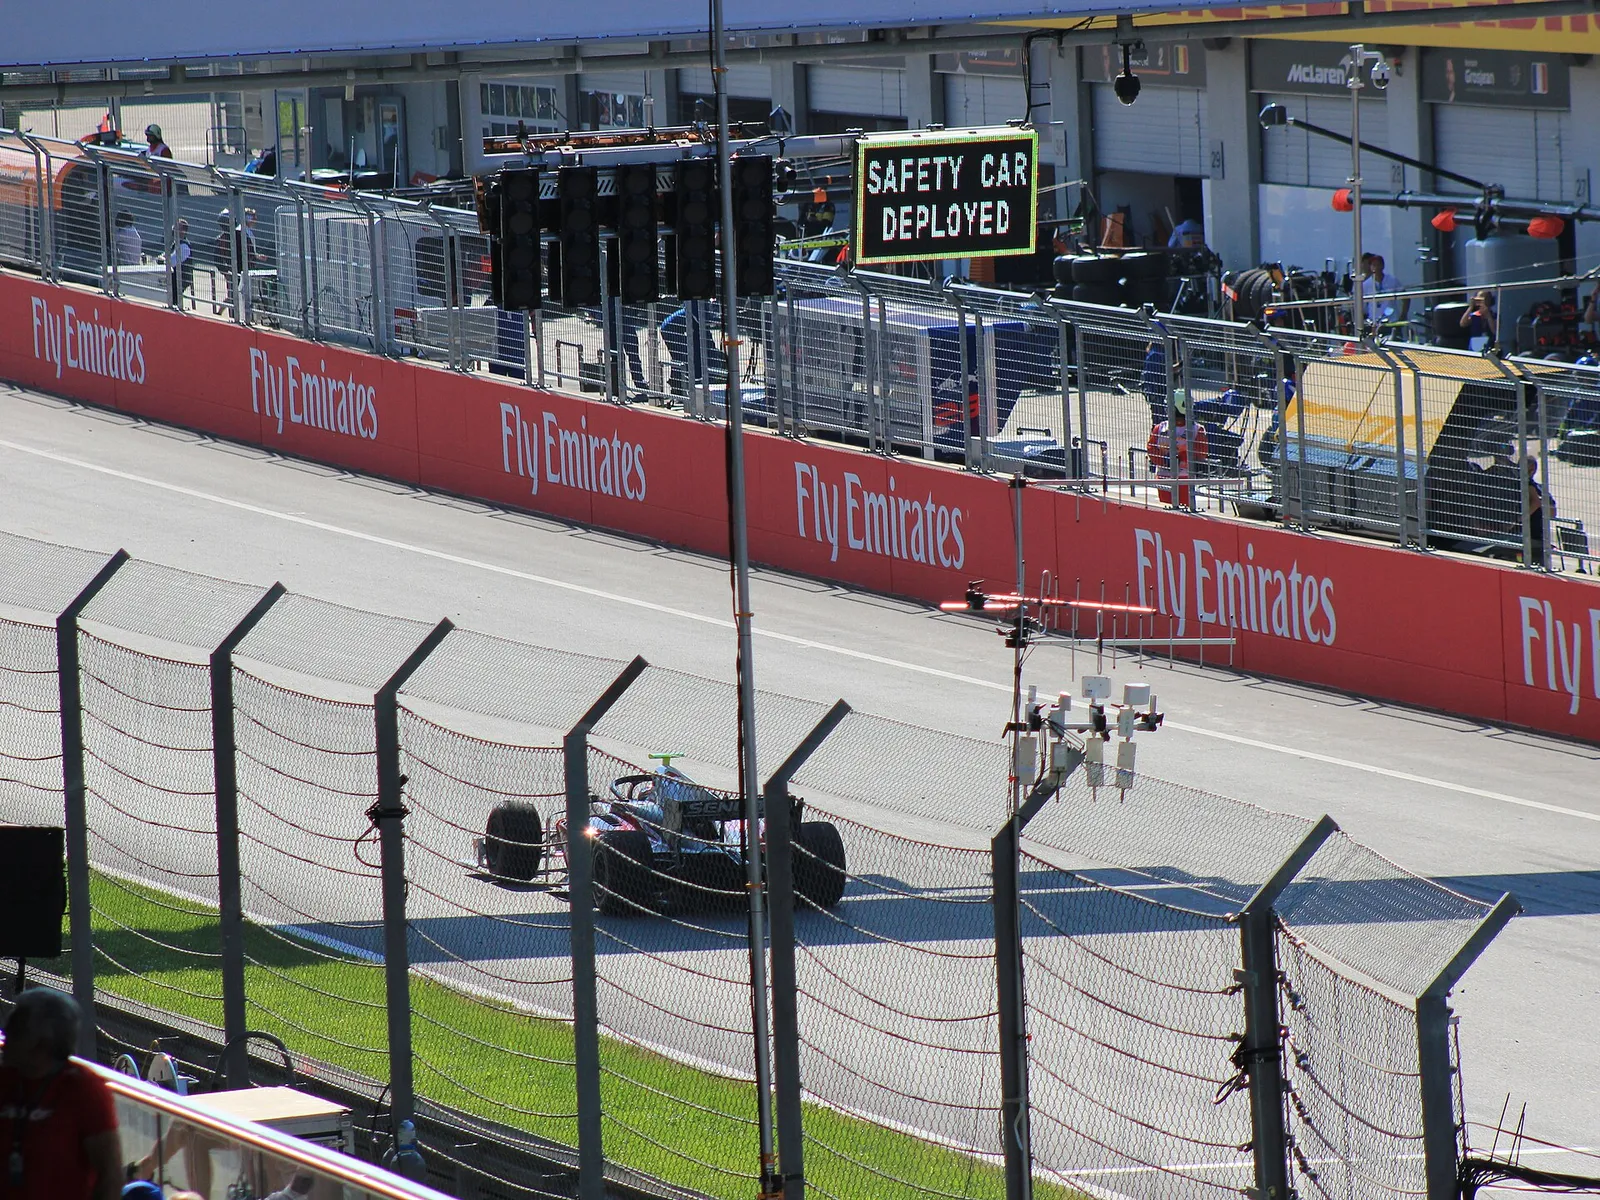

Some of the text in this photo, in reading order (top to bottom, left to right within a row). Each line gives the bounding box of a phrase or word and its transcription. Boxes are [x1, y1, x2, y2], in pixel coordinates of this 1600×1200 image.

[1287, 64, 1345, 85] McLaren
[867, 151, 1028, 194] SAFETY CAR
[882, 200, 1010, 241] DEPLOYED
[31, 296, 145, 385] Fly Emirates
[249, 346, 378, 440] Fly Emirates
[499, 401, 646, 502] Fly Emirates
[794, 461, 965, 570] Fly Emirates
[1134, 528, 1337, 646] Fly Emirates
[1519, 596, 1582, 715] Fly
